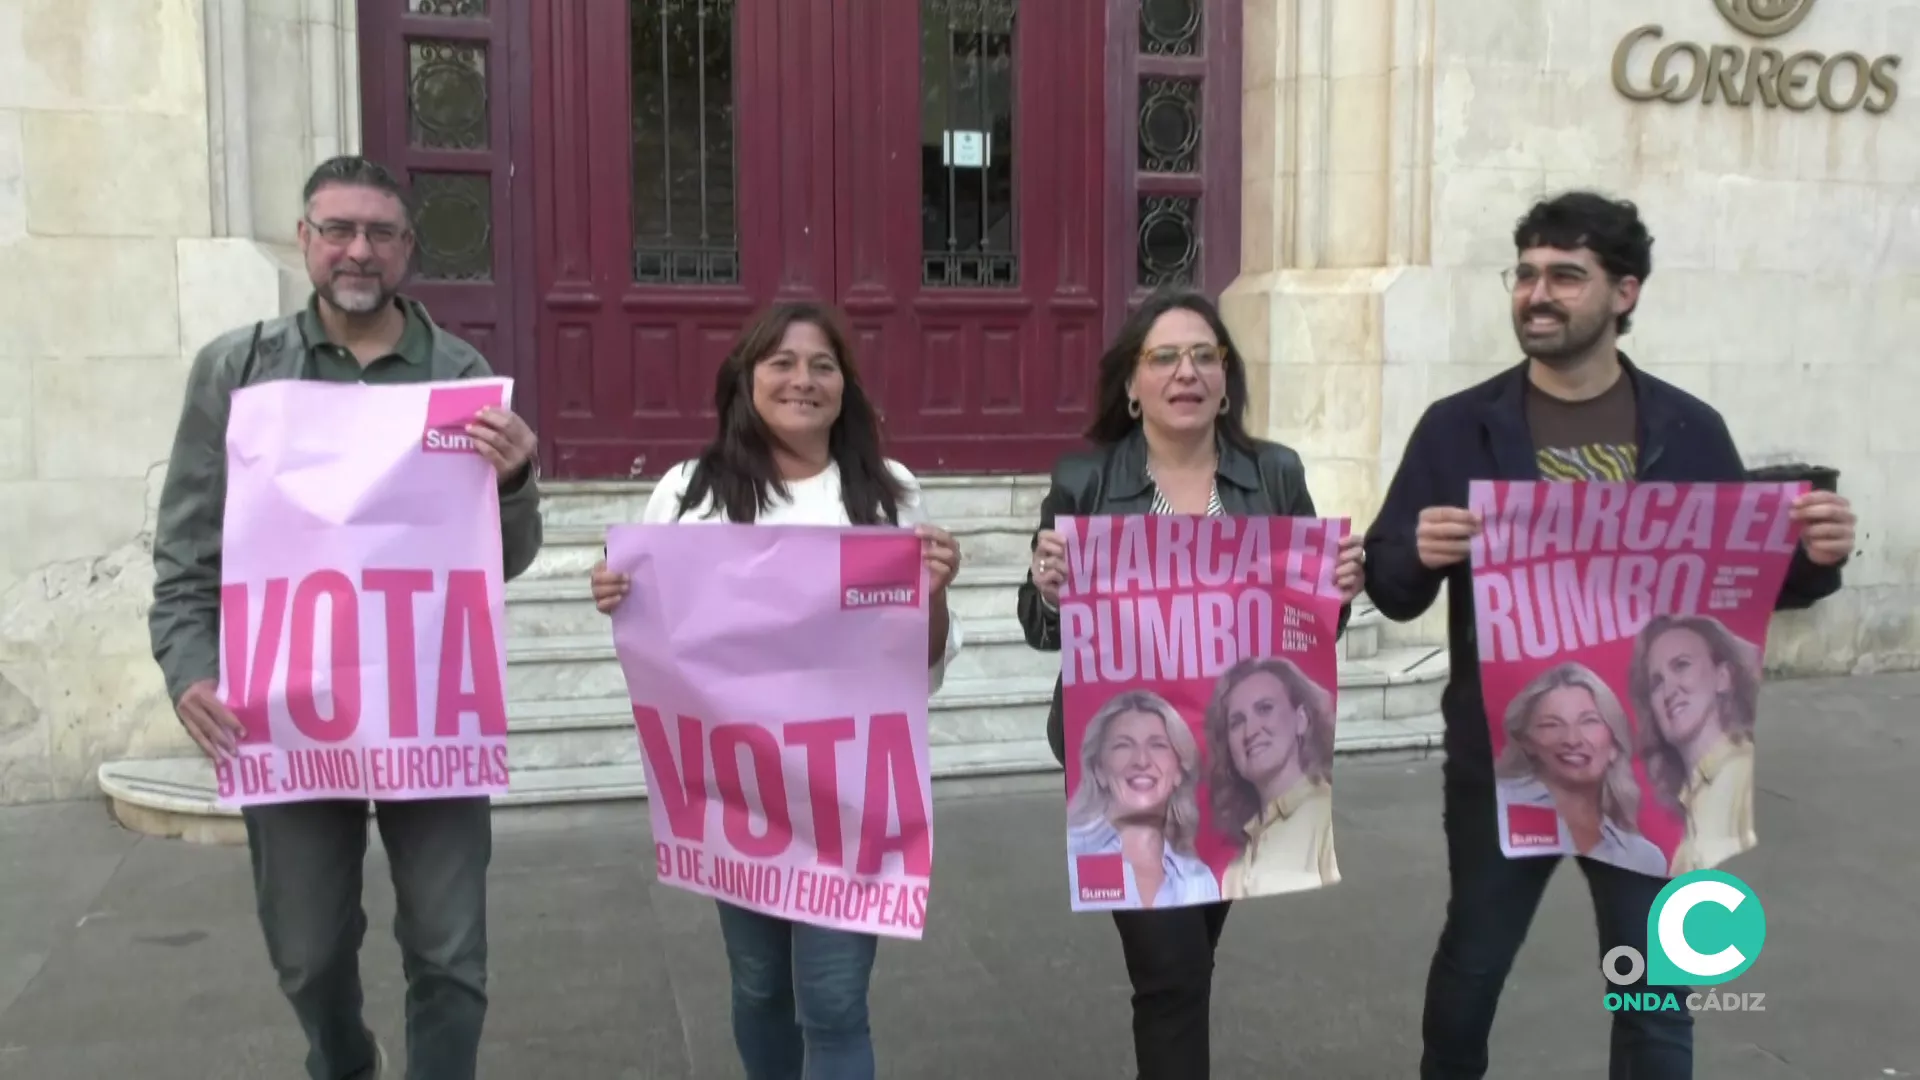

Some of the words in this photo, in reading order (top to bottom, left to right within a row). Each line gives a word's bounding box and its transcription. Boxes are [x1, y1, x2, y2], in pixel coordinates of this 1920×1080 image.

[1611, 23, 1902, 114] CORREOS
[426, 429, 474, 449] Sum
[1055, 514, 1273, 597] MARCA
[1284, 516, 1342, 600] EL
[1468, 480, 1718, 569] MARCA
[1724, 480, 1800, 554] EL
[845, 587, 916, 606] Sumar
[1058, 587, 1273, 687] RUMBO
[1472, 553, 1707, 663] RUMBO
[221, 568, 508, 744] VOTA
[216, 757, 235, 798] 9
[240, 752, 277, 796] DE
[281, 748, 360, 792] JUNIO
[371, 744, 509, 791] EUROPEAS
[631, 703, 932, 878] VOTA
[655, 842, 672, 878] 9
[676, 845, 705, 885] DE
[708, 854, 782, 907] JUNIO
[796, 868, 928, 929] EUROPEAS
[1081, 886, 1123, 900] Sumar
